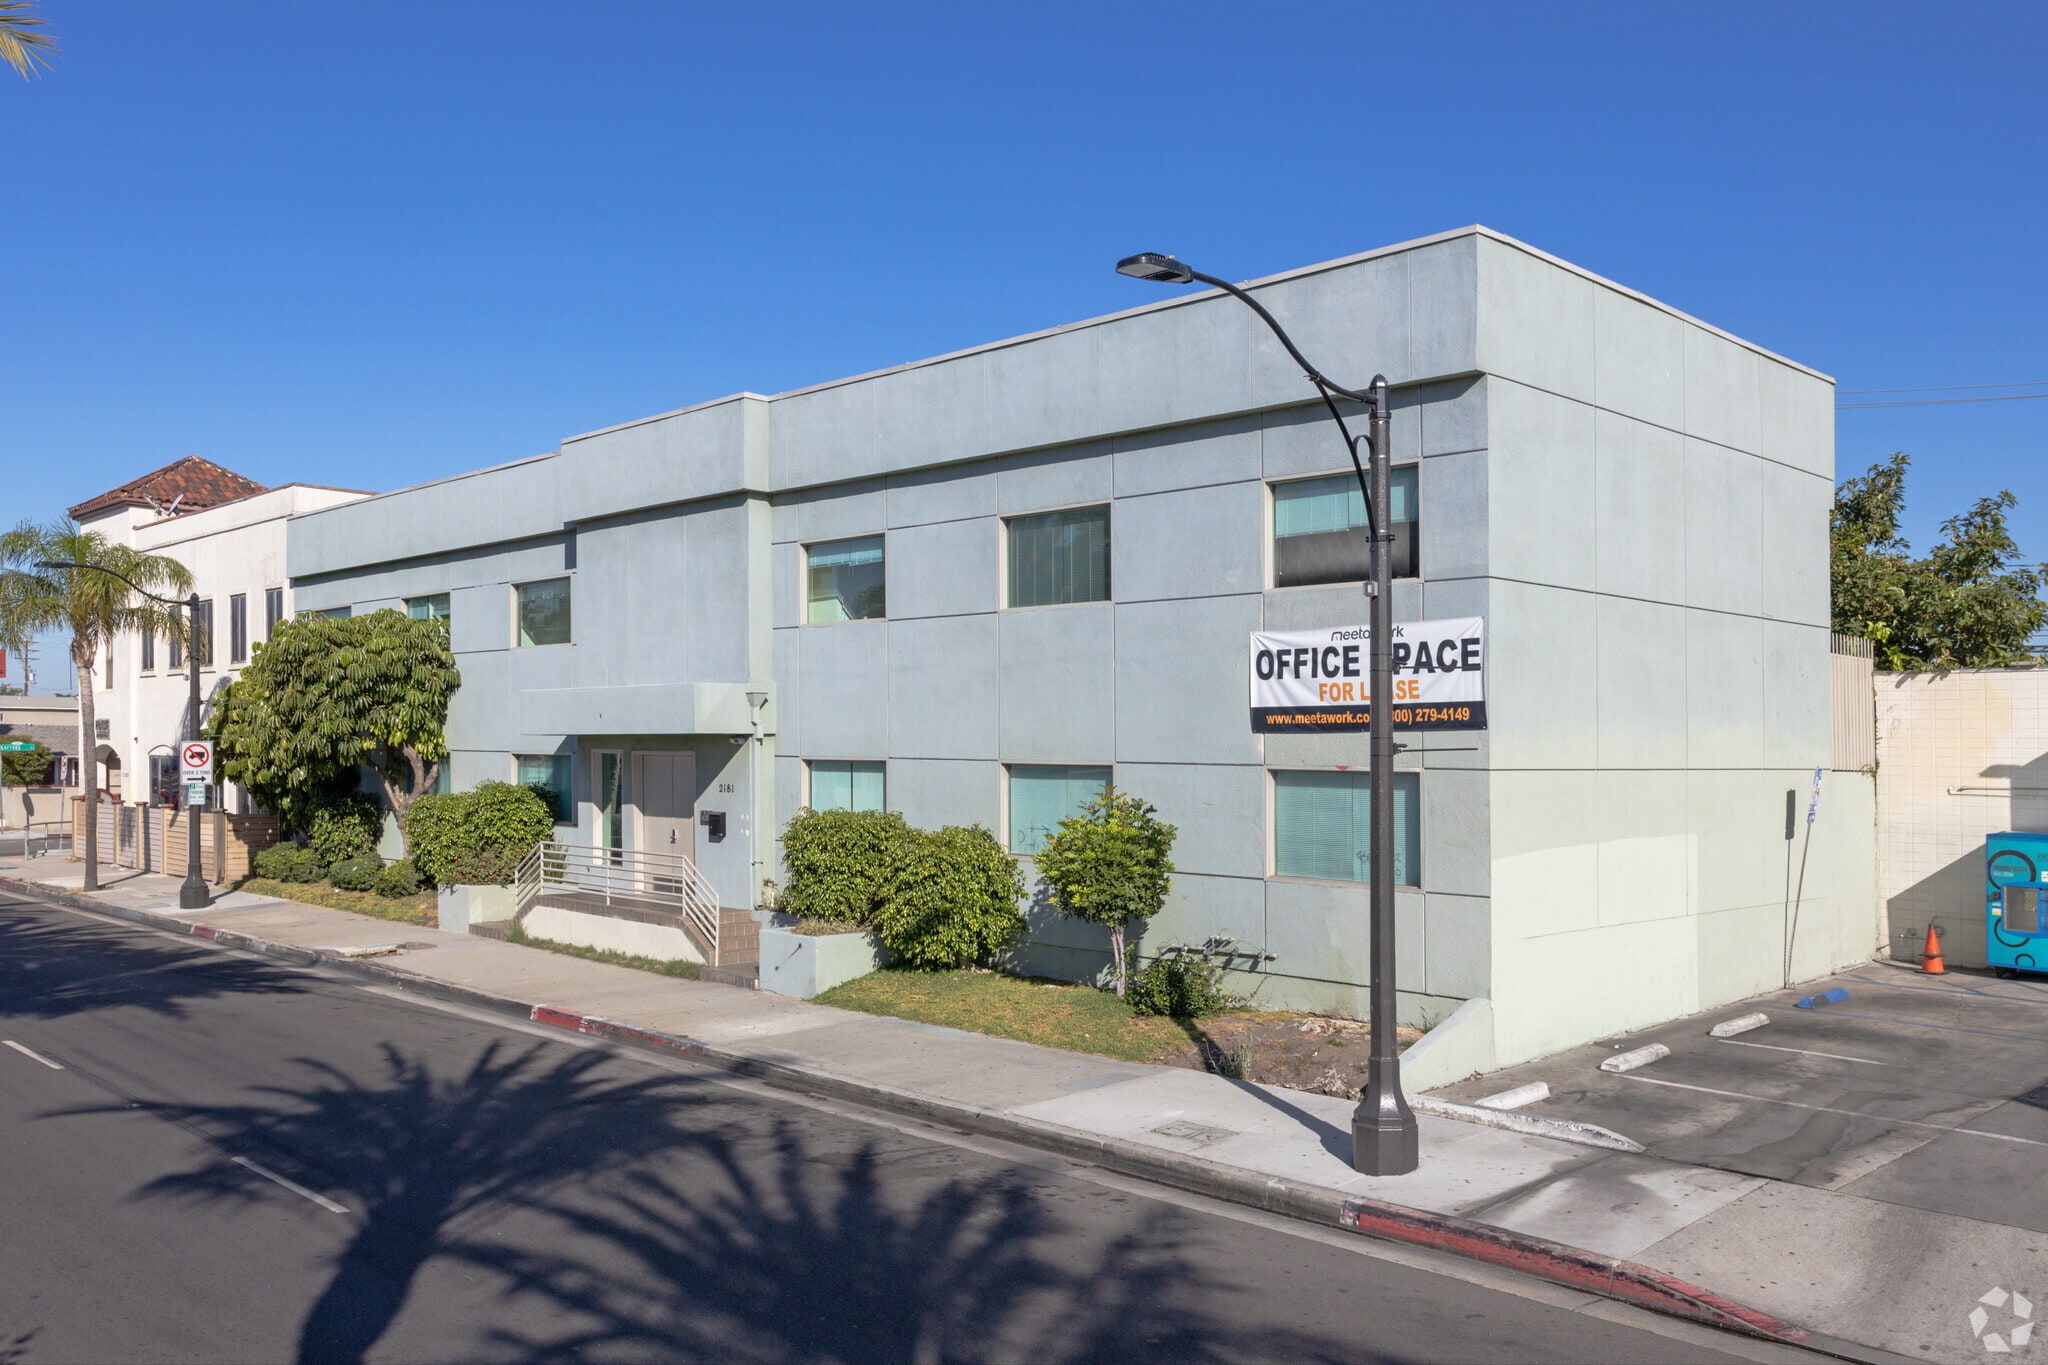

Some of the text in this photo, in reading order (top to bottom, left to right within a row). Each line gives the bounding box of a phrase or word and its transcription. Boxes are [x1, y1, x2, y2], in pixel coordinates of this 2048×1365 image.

[1331, 625, 1404, 642] meetark
[1256, 638, 1481, 680] OFFICE PACE
[1319, 680, 1420, 702] FOR LSE
[1266, 711, 1370, 724] www.meetawork.co
[1415, 707, 1470, 722] 279-4149
[719, 783, 734, 793] 2181
